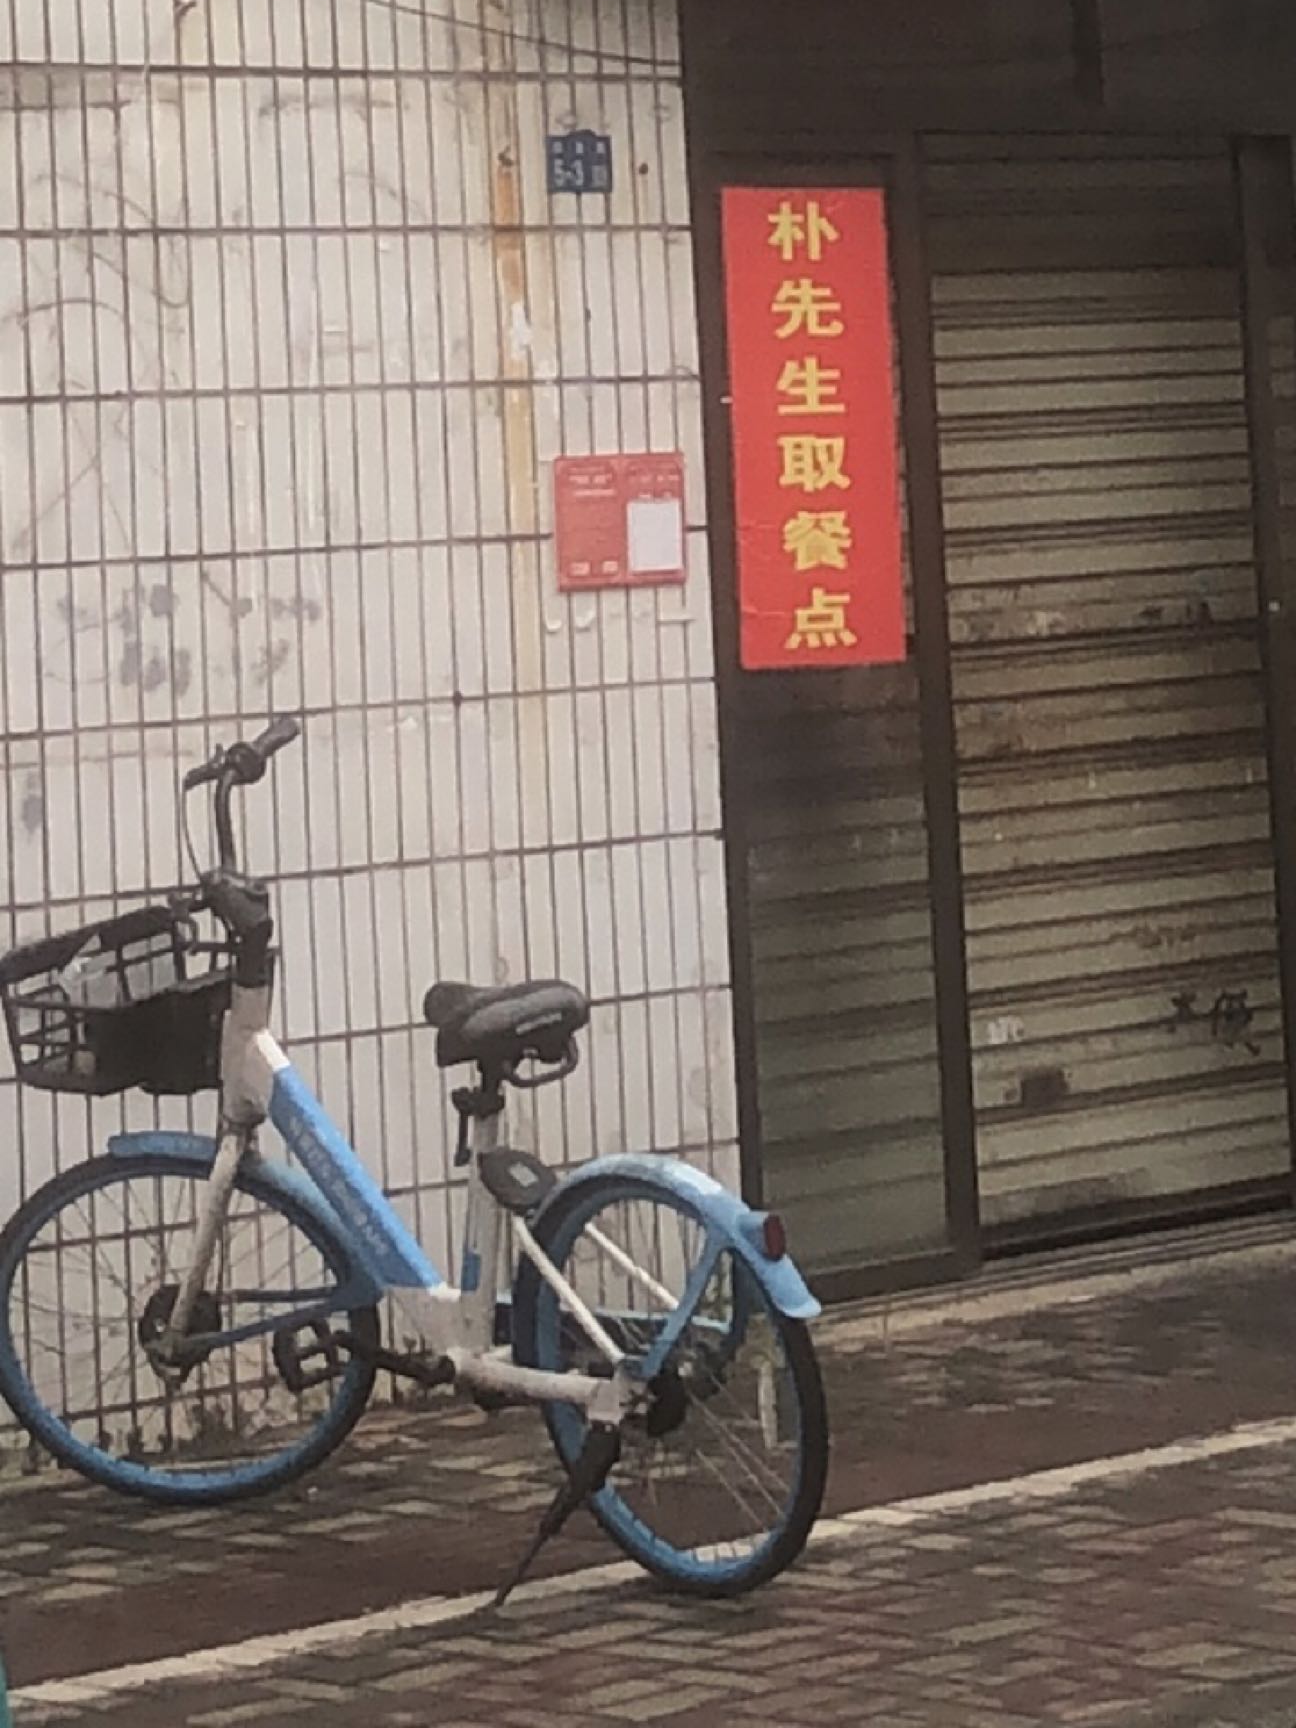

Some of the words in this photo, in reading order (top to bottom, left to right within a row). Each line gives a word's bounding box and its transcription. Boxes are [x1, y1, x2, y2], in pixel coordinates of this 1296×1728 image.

[767, 200, 860, 650] 朴先生取餐点
